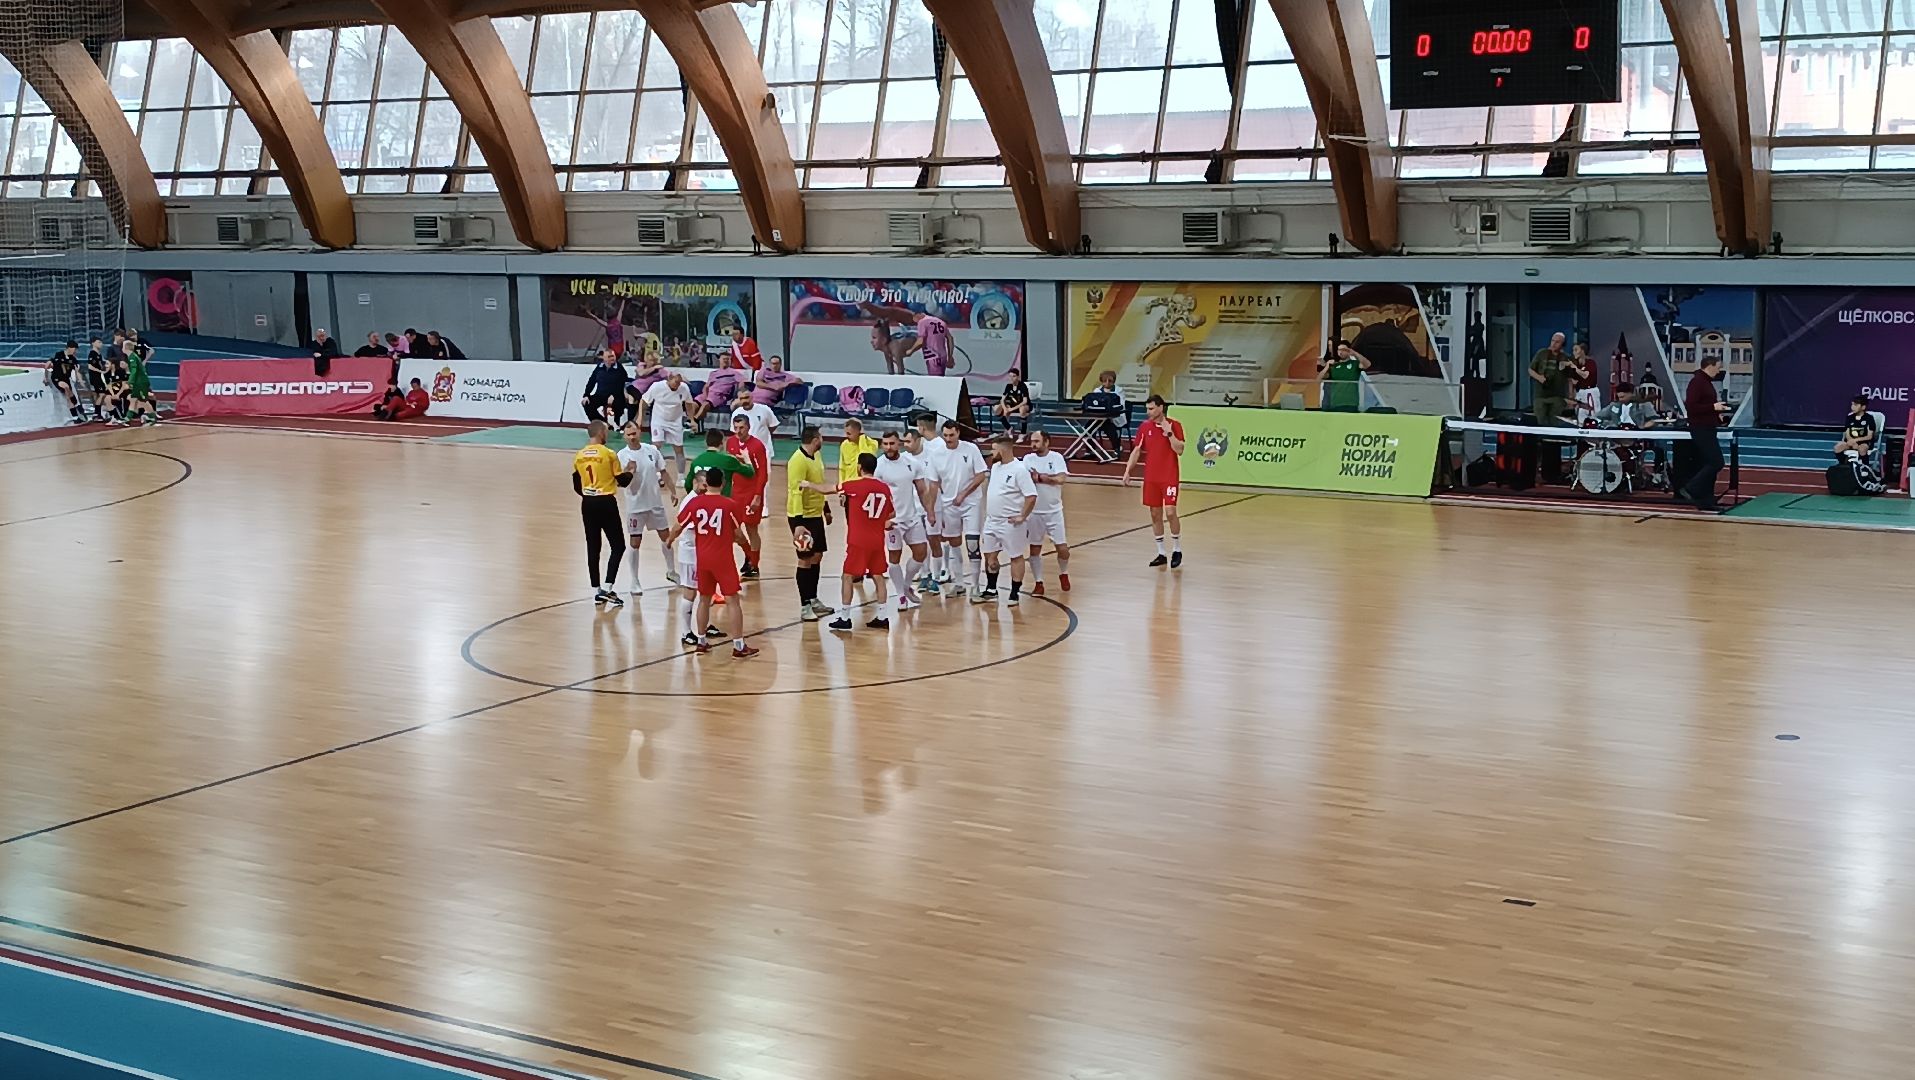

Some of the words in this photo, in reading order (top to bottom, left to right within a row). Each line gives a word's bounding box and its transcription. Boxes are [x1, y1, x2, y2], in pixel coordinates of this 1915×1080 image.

[1417, 34, 1431, 57] 0
[1575, 26, 1590, 49] 0
[570, 278, 597, 296] УСК
[880, 287, 902, 303] ЭТО
[1218, 295, 1282, 307] ЛАУРЕАТ
[1838, 308, 1915, 325] ЩЁЛКОВС
[463, 378, 511, 388] КОМАНДА
[460, 391, 526, 403] ГУБЕРНАТОРА
[1239, 435, 1306, 449] МИНСПОРТ
[1237, 450, 1287, 463] РОССИИ
[1341, 448, 1397, 463] НОРМА
[585, 464, 594, 484] 1
[1338, 462, 1393, 479] ЖИЗНИ
[862, 492, 886, 519] 47
[696, 508, 723, 536] 24
